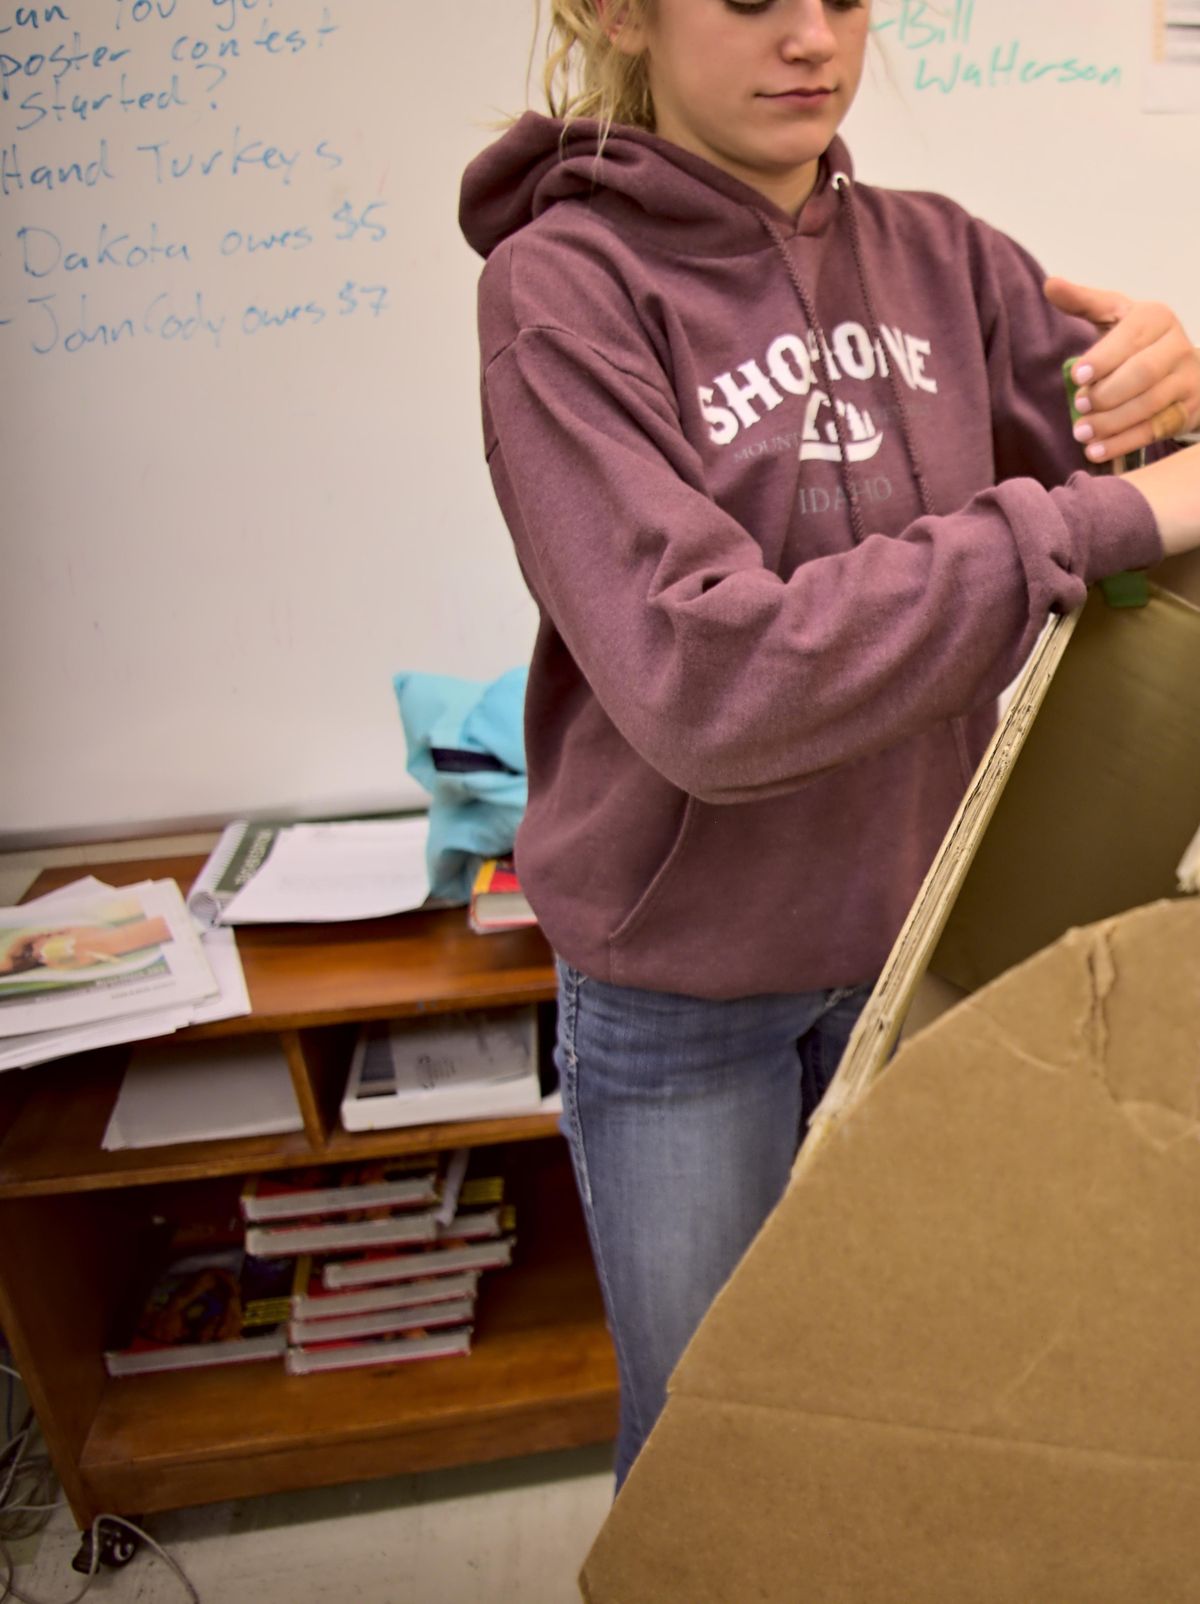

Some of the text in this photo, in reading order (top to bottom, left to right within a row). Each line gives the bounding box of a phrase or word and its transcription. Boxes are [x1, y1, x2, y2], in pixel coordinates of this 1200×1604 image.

[0, 4, 70, 33] an
[172, 8, 338, 62] contest
[1, 139, 115, 196] Hand
[17, 200, 388, 278] Dakota owes $5
[241, 300, 326, 335] owes
[337, 280, 389, 318] $7
